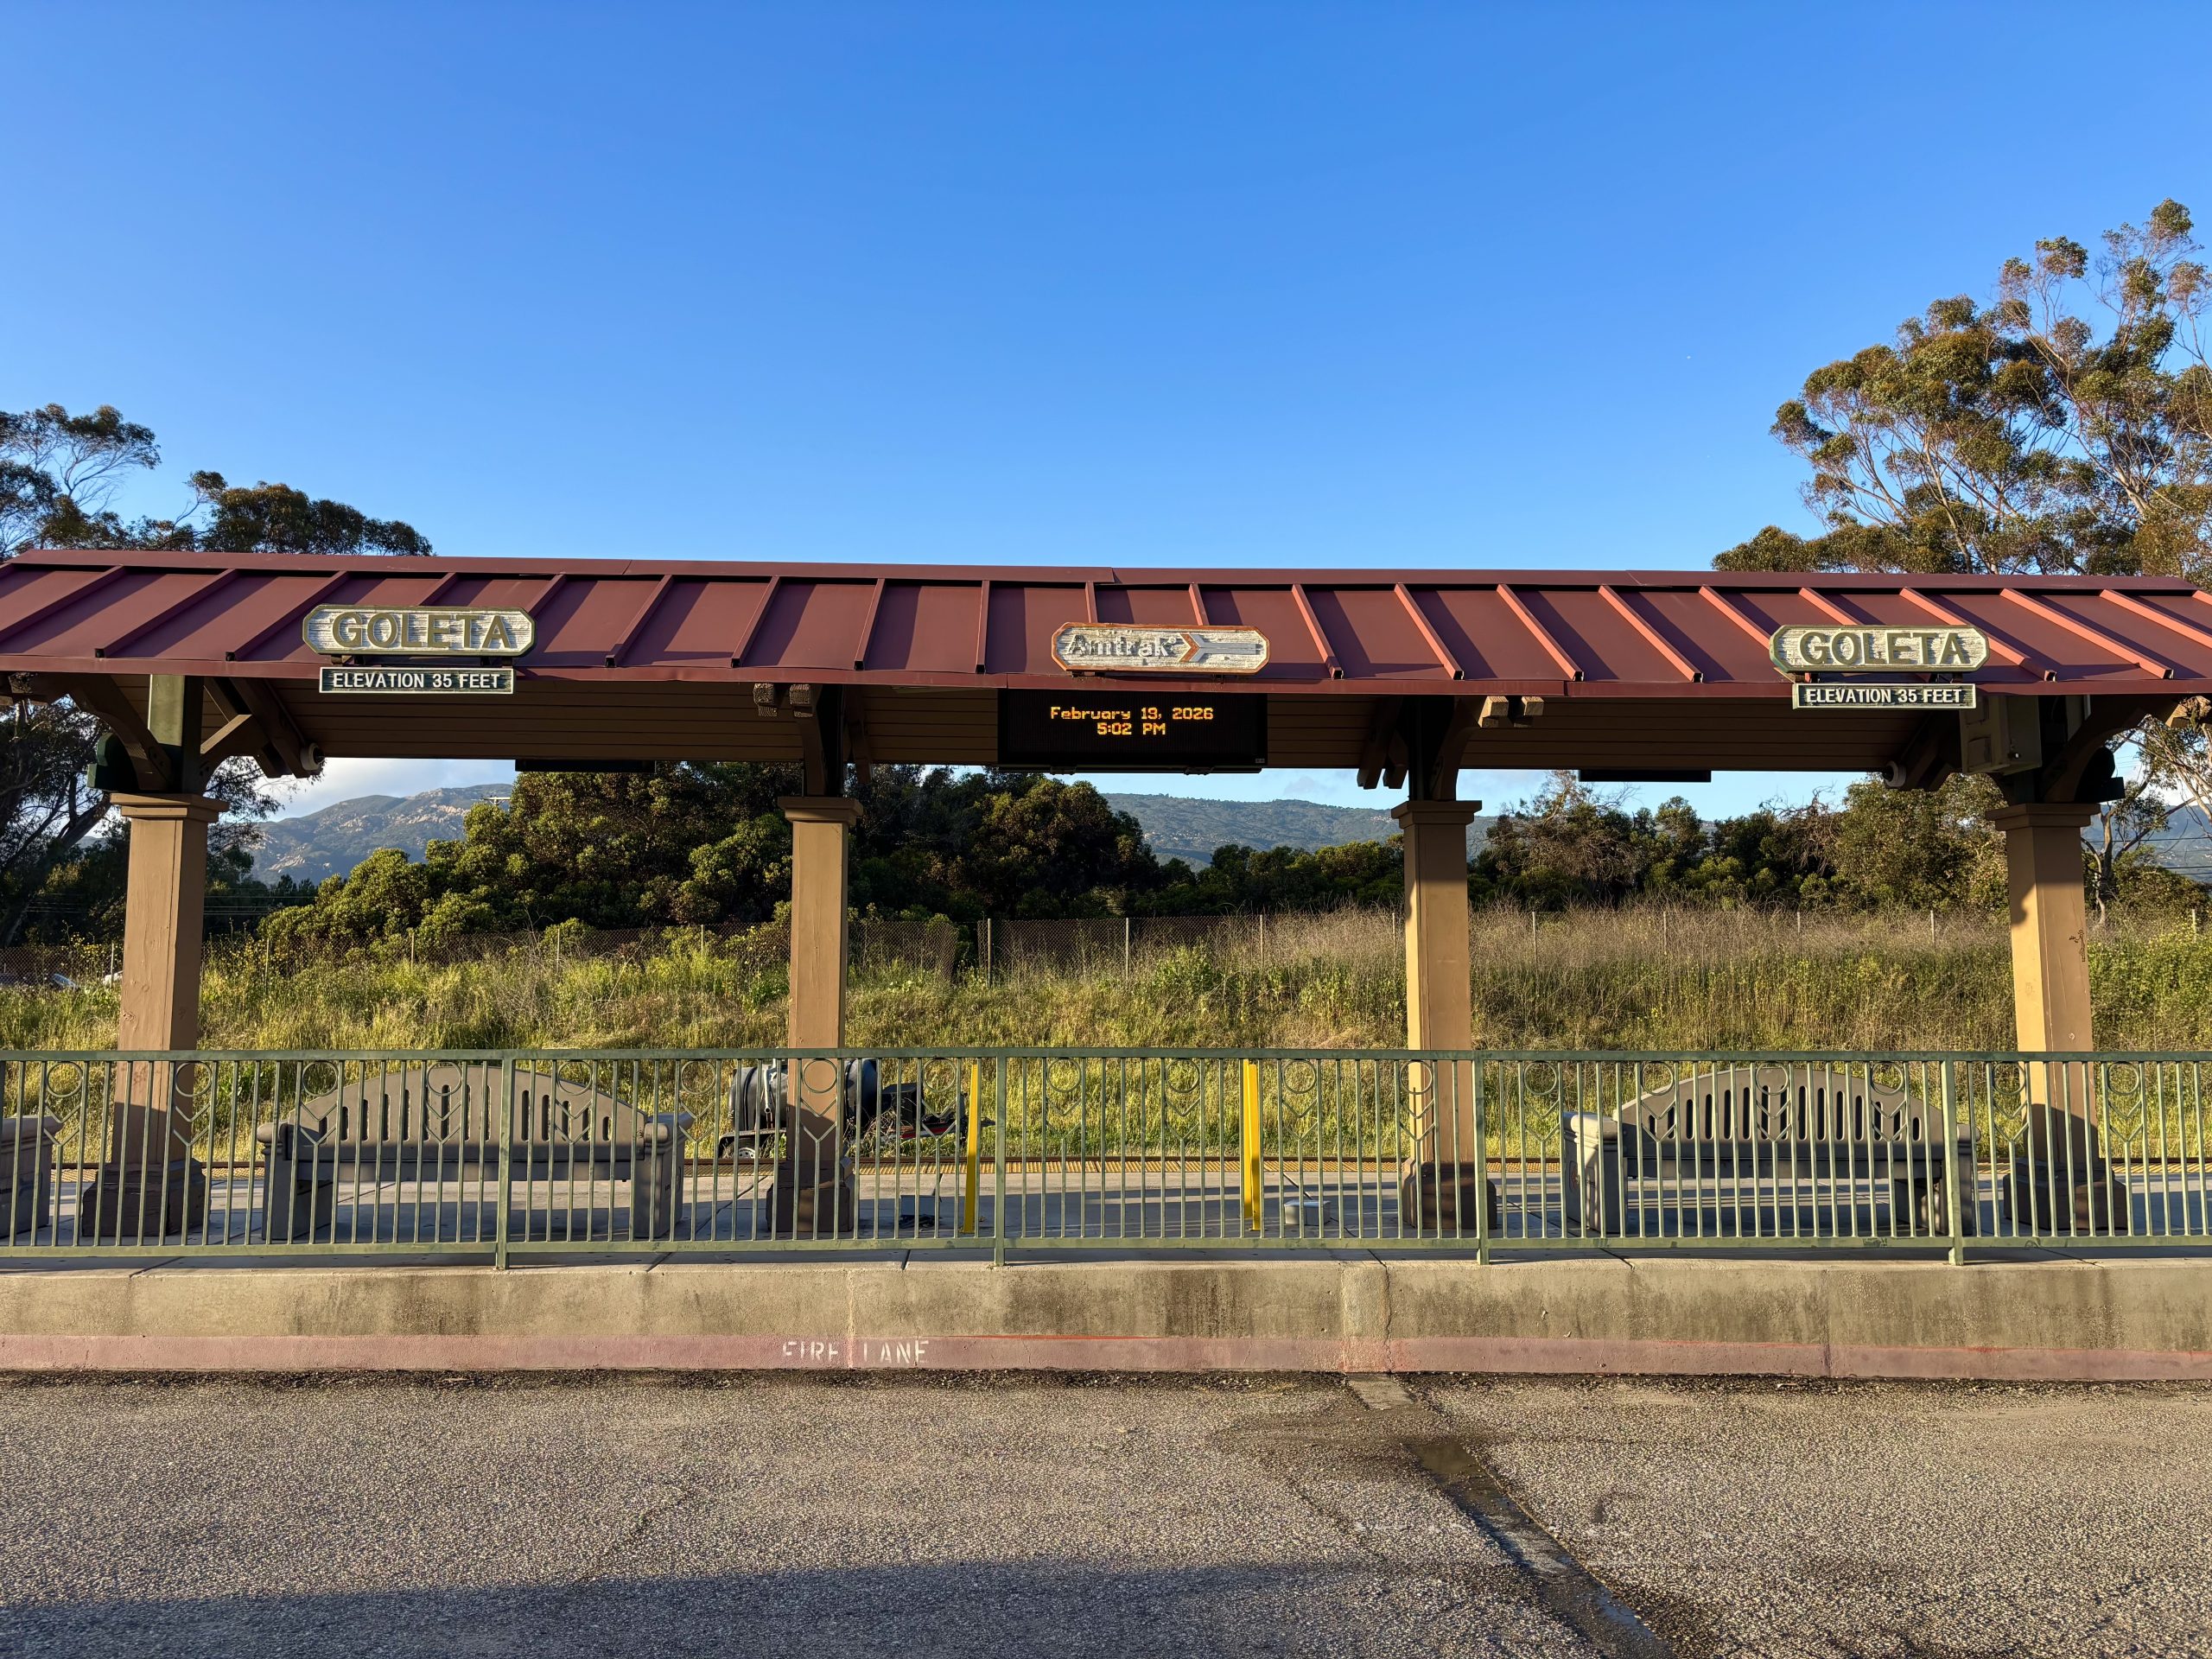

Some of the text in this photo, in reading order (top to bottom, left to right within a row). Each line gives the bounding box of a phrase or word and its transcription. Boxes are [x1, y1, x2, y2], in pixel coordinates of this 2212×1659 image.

[332, 611, 512, 648] GOLETA
[1799, 631, 1971, 665] GOLETA
[333, 672, 500, 689] ELEVATION 35 FEET
[1806, 689, 1962, 704] ELEVATION 35 FEET
[1050, 706, 1131, 720] February
[1172, 707, 1214, 720] 2026
[1096, 722, 1166, 734] 5:02 PM
